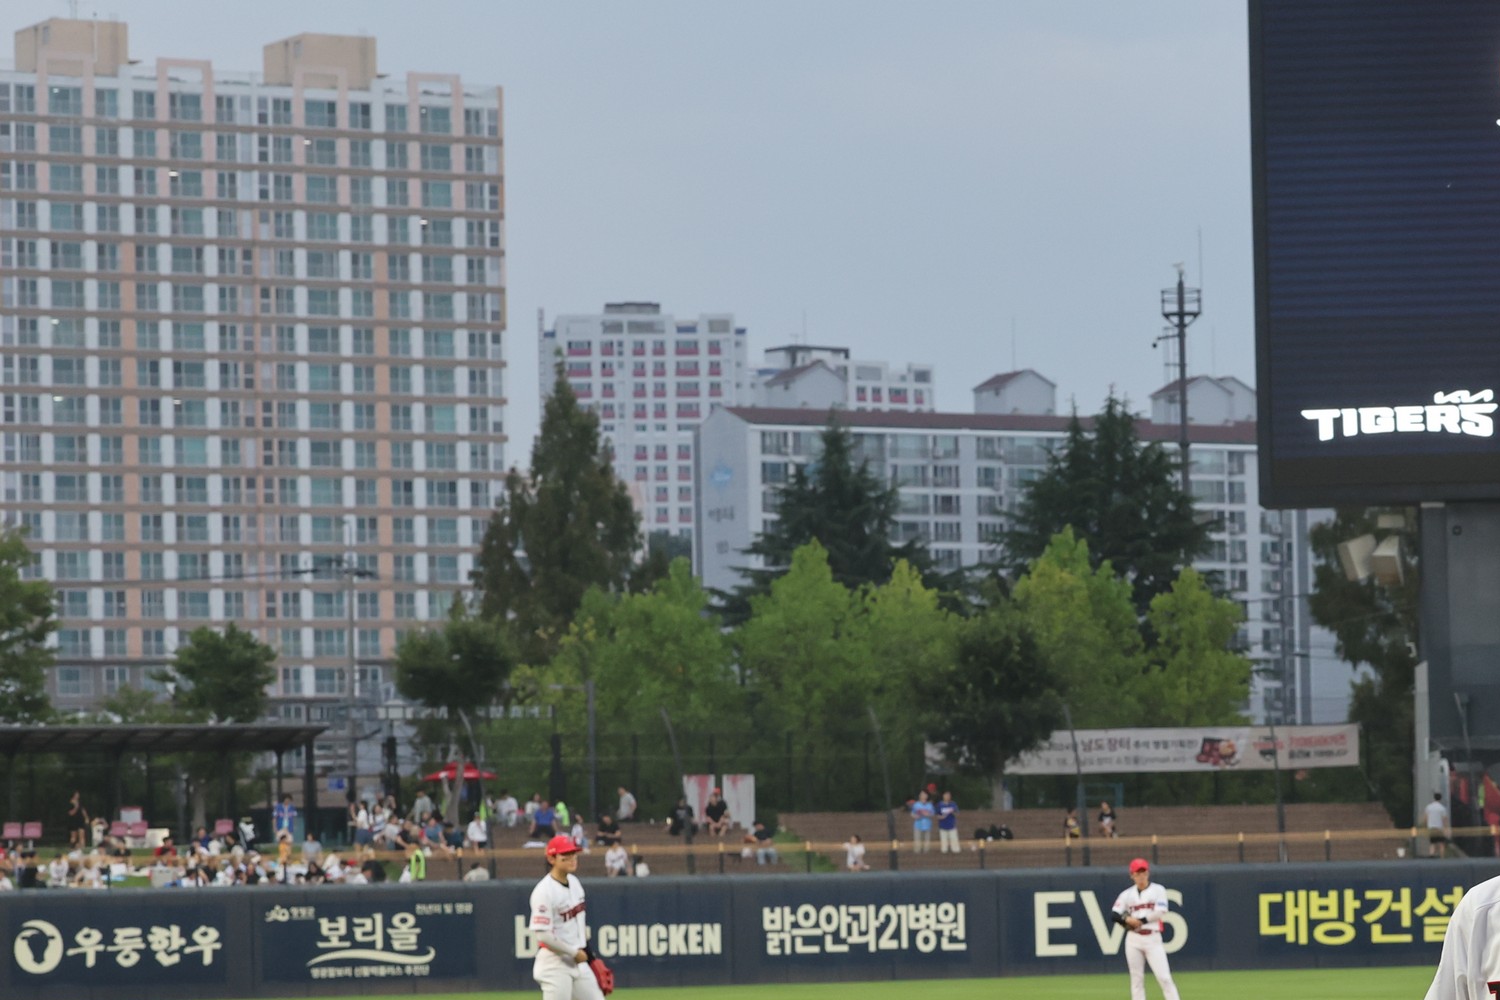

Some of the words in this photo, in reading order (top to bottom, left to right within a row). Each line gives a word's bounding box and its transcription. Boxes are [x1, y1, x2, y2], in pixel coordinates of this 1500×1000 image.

[1301, 403, 1498, 442] TIGERS
[316, 912, 422, 951] 보리올
[762, 902, 967, 955] 밝은안과21병원
[1258, 886, 1463, 945] 대방건설
[598, 922, 722, 957] CHICKEN
